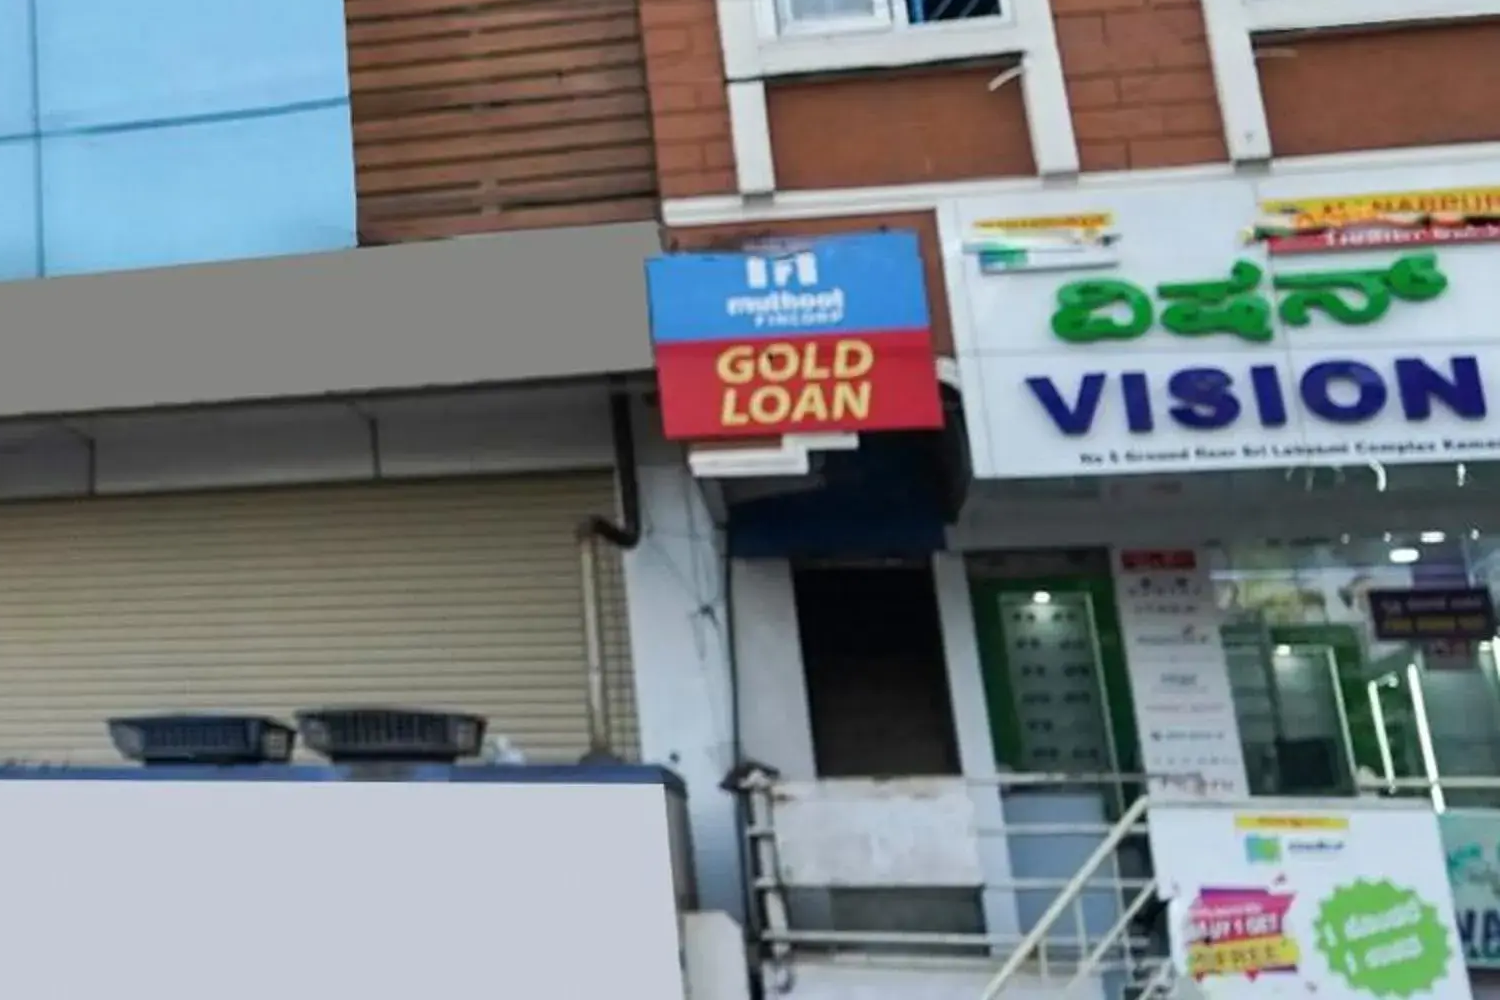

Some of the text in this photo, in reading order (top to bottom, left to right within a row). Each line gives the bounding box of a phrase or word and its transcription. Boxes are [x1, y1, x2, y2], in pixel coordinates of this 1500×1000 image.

[716, 339, 875, 384] GOLD
[721, 381, 872, 427] LOAN
[1024, 355, 1488, 437] VISION
